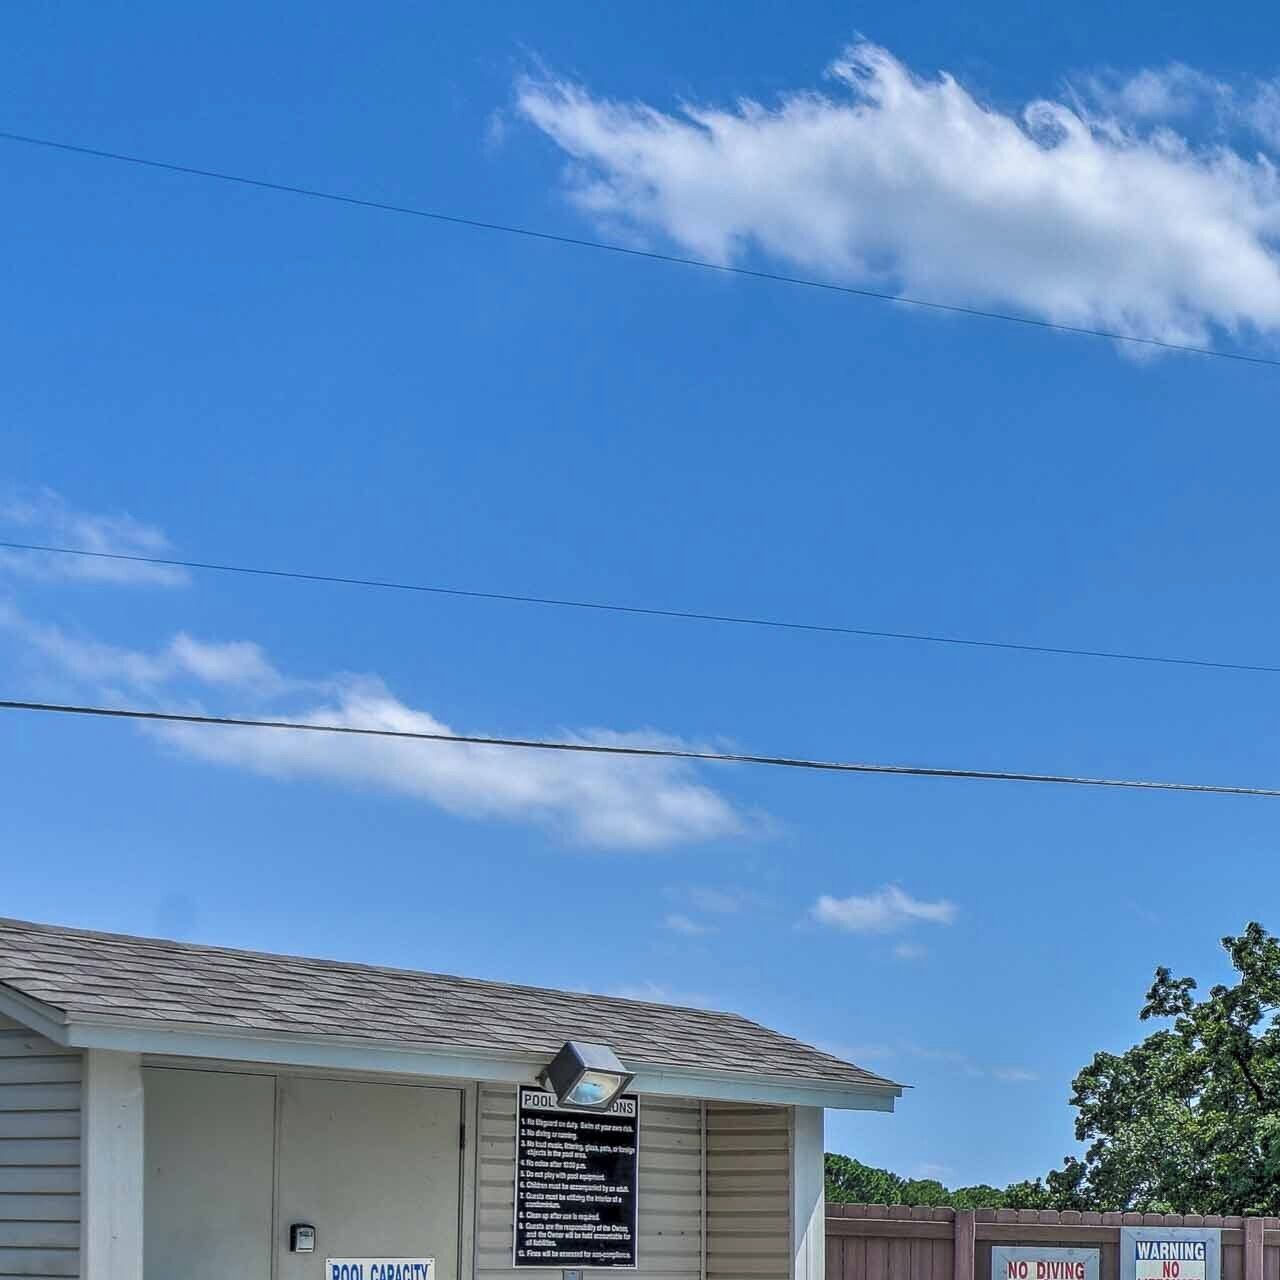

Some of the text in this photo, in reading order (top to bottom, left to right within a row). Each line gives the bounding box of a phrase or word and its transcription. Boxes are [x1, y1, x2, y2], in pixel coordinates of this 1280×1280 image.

[524, 1095, 554, 1107] POOL
[1137, 1242, 1204, 1259] WARNING
[1008, 1261, 1084, 1279] NO DIVING
[1163, 1262, 1179, 1278] NO
